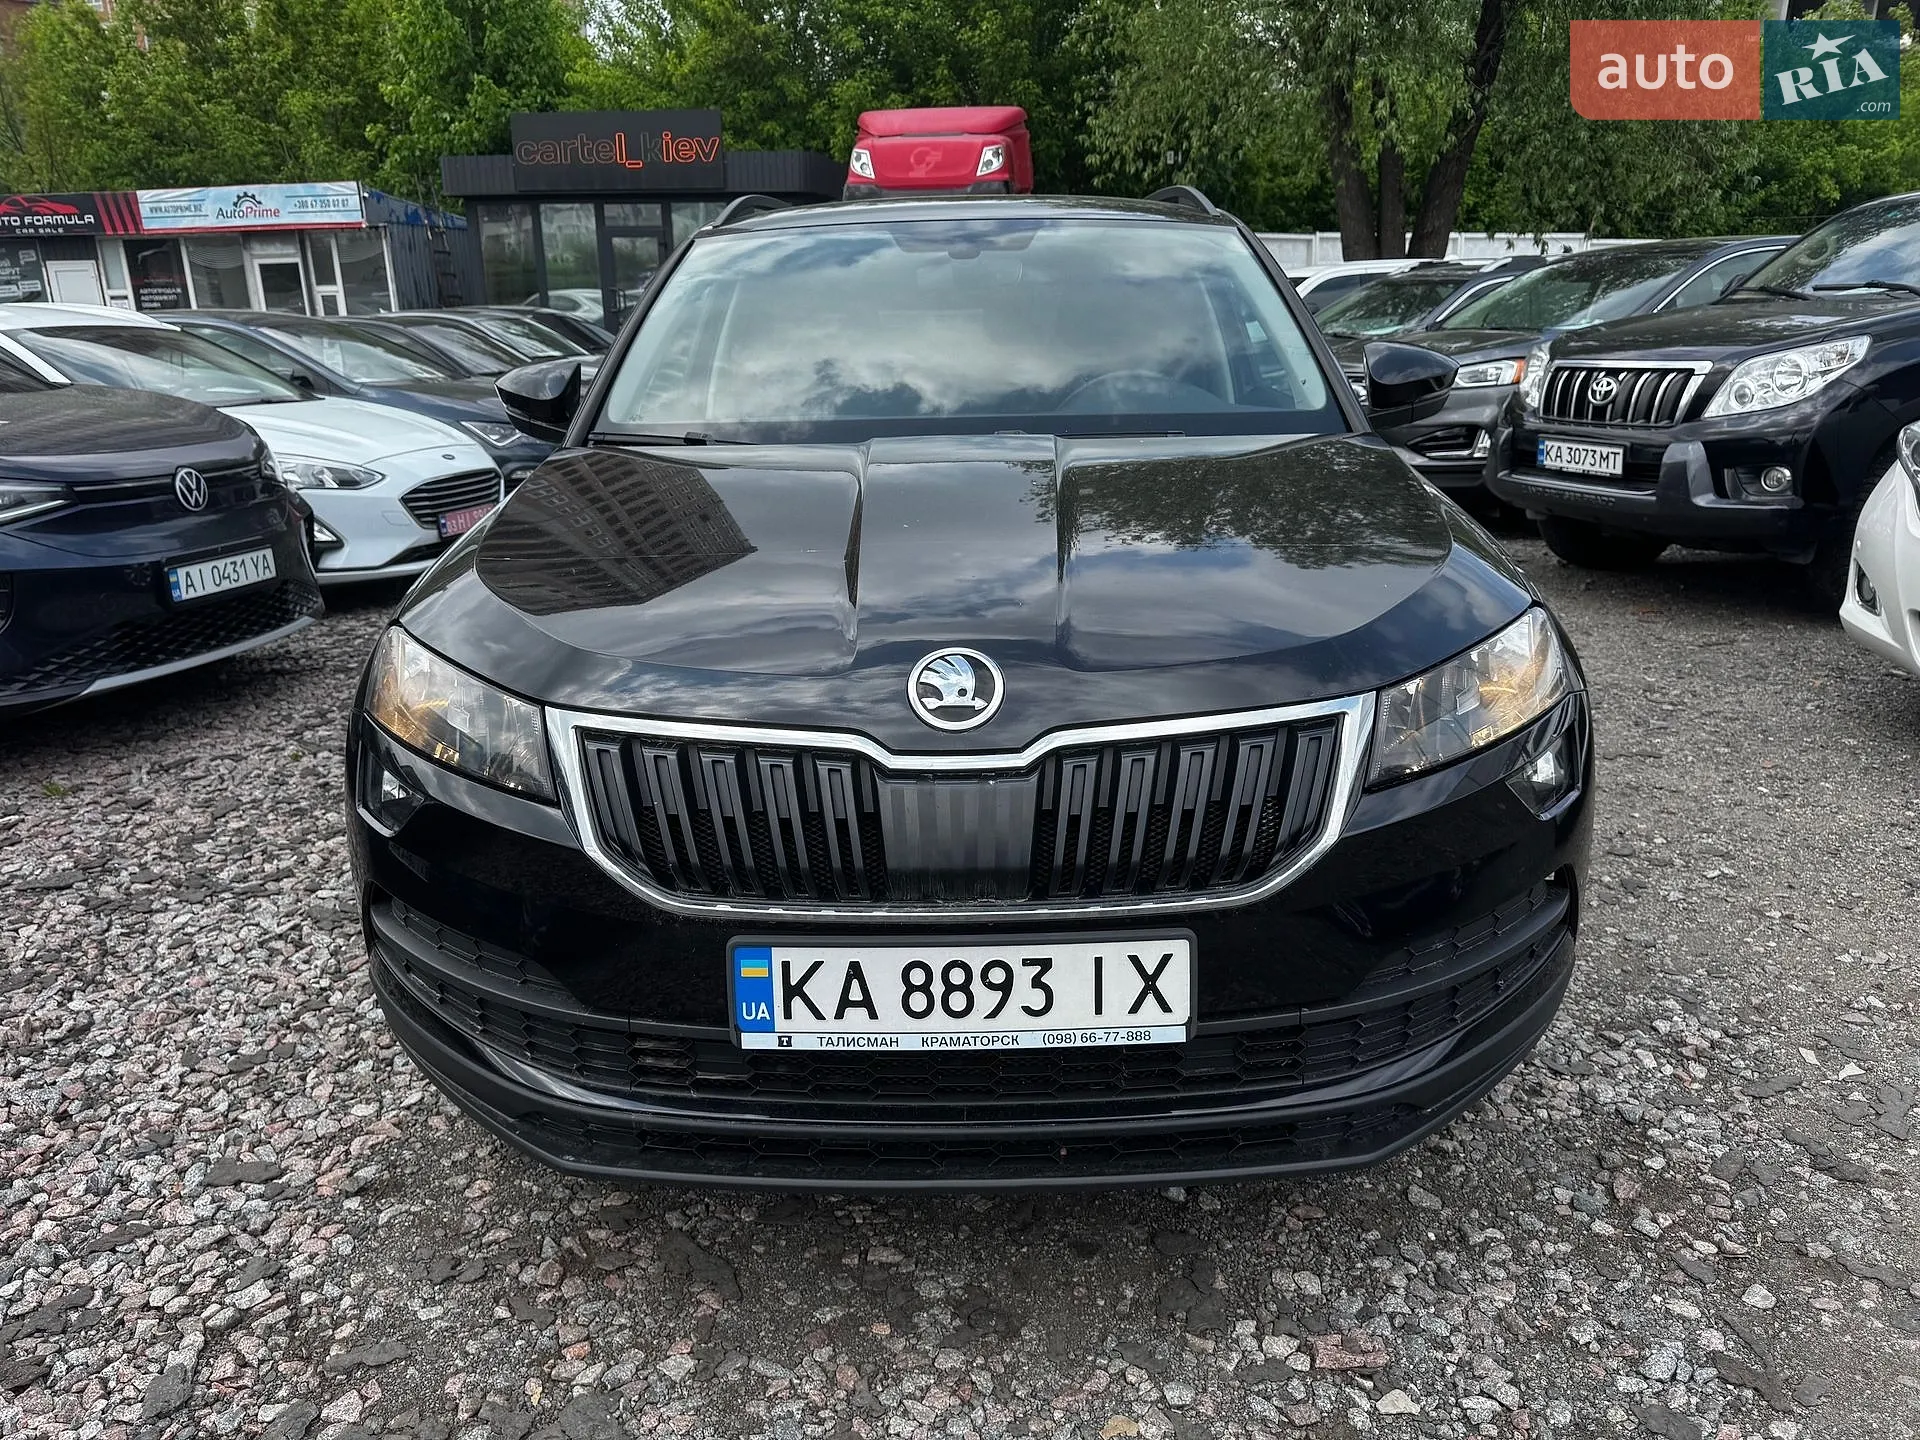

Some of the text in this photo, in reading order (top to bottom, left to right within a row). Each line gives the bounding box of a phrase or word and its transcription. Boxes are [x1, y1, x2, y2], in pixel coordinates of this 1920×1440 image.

[515, 131, 719, 168] cartel_kiev
[24, 214, 95, 226] FORMULA
[215, 205, 280, 220] AutoPrime
[1544, 443, 1563, 463] KA
[1565, 446, 1597, 467] 3073
[1599, 450, 1620, 470] MT
[185, 553, 273, 595] AI 0431 YA
[780, 952, 1175, 1021] KA 8893 IX
[742, 1002, 771, 1021] UA
[817, 1036, 899, 1048] ТАЛИСМАН
[921, 1035, 1020, 1048] КРАМАТОРСК
[1042, 1031, 1078, 1047] (098)
[1080, 1029, 1152, 1044] 66-77-888
